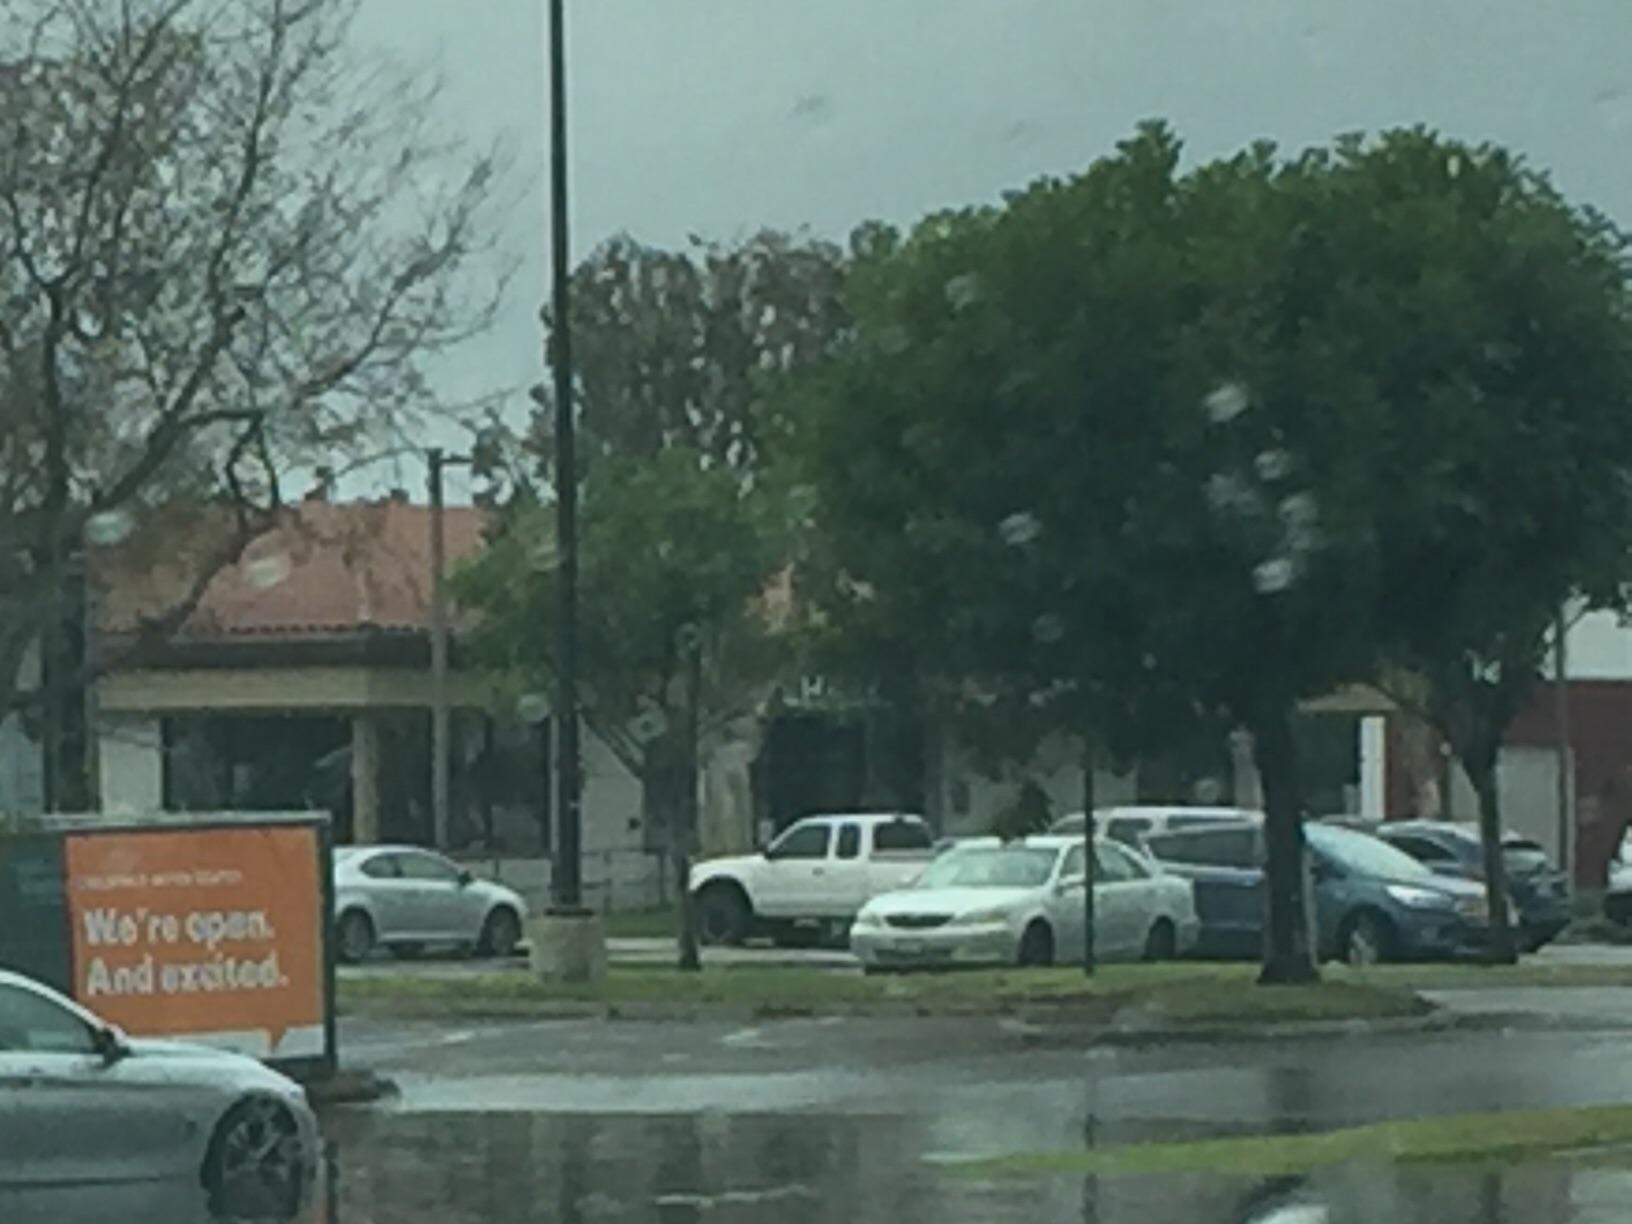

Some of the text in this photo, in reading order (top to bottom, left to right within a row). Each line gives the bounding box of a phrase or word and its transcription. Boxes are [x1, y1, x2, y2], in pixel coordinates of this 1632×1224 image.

[83, 907, 274, 950] We're open.
[87, 951, 290, 995] And excited.
